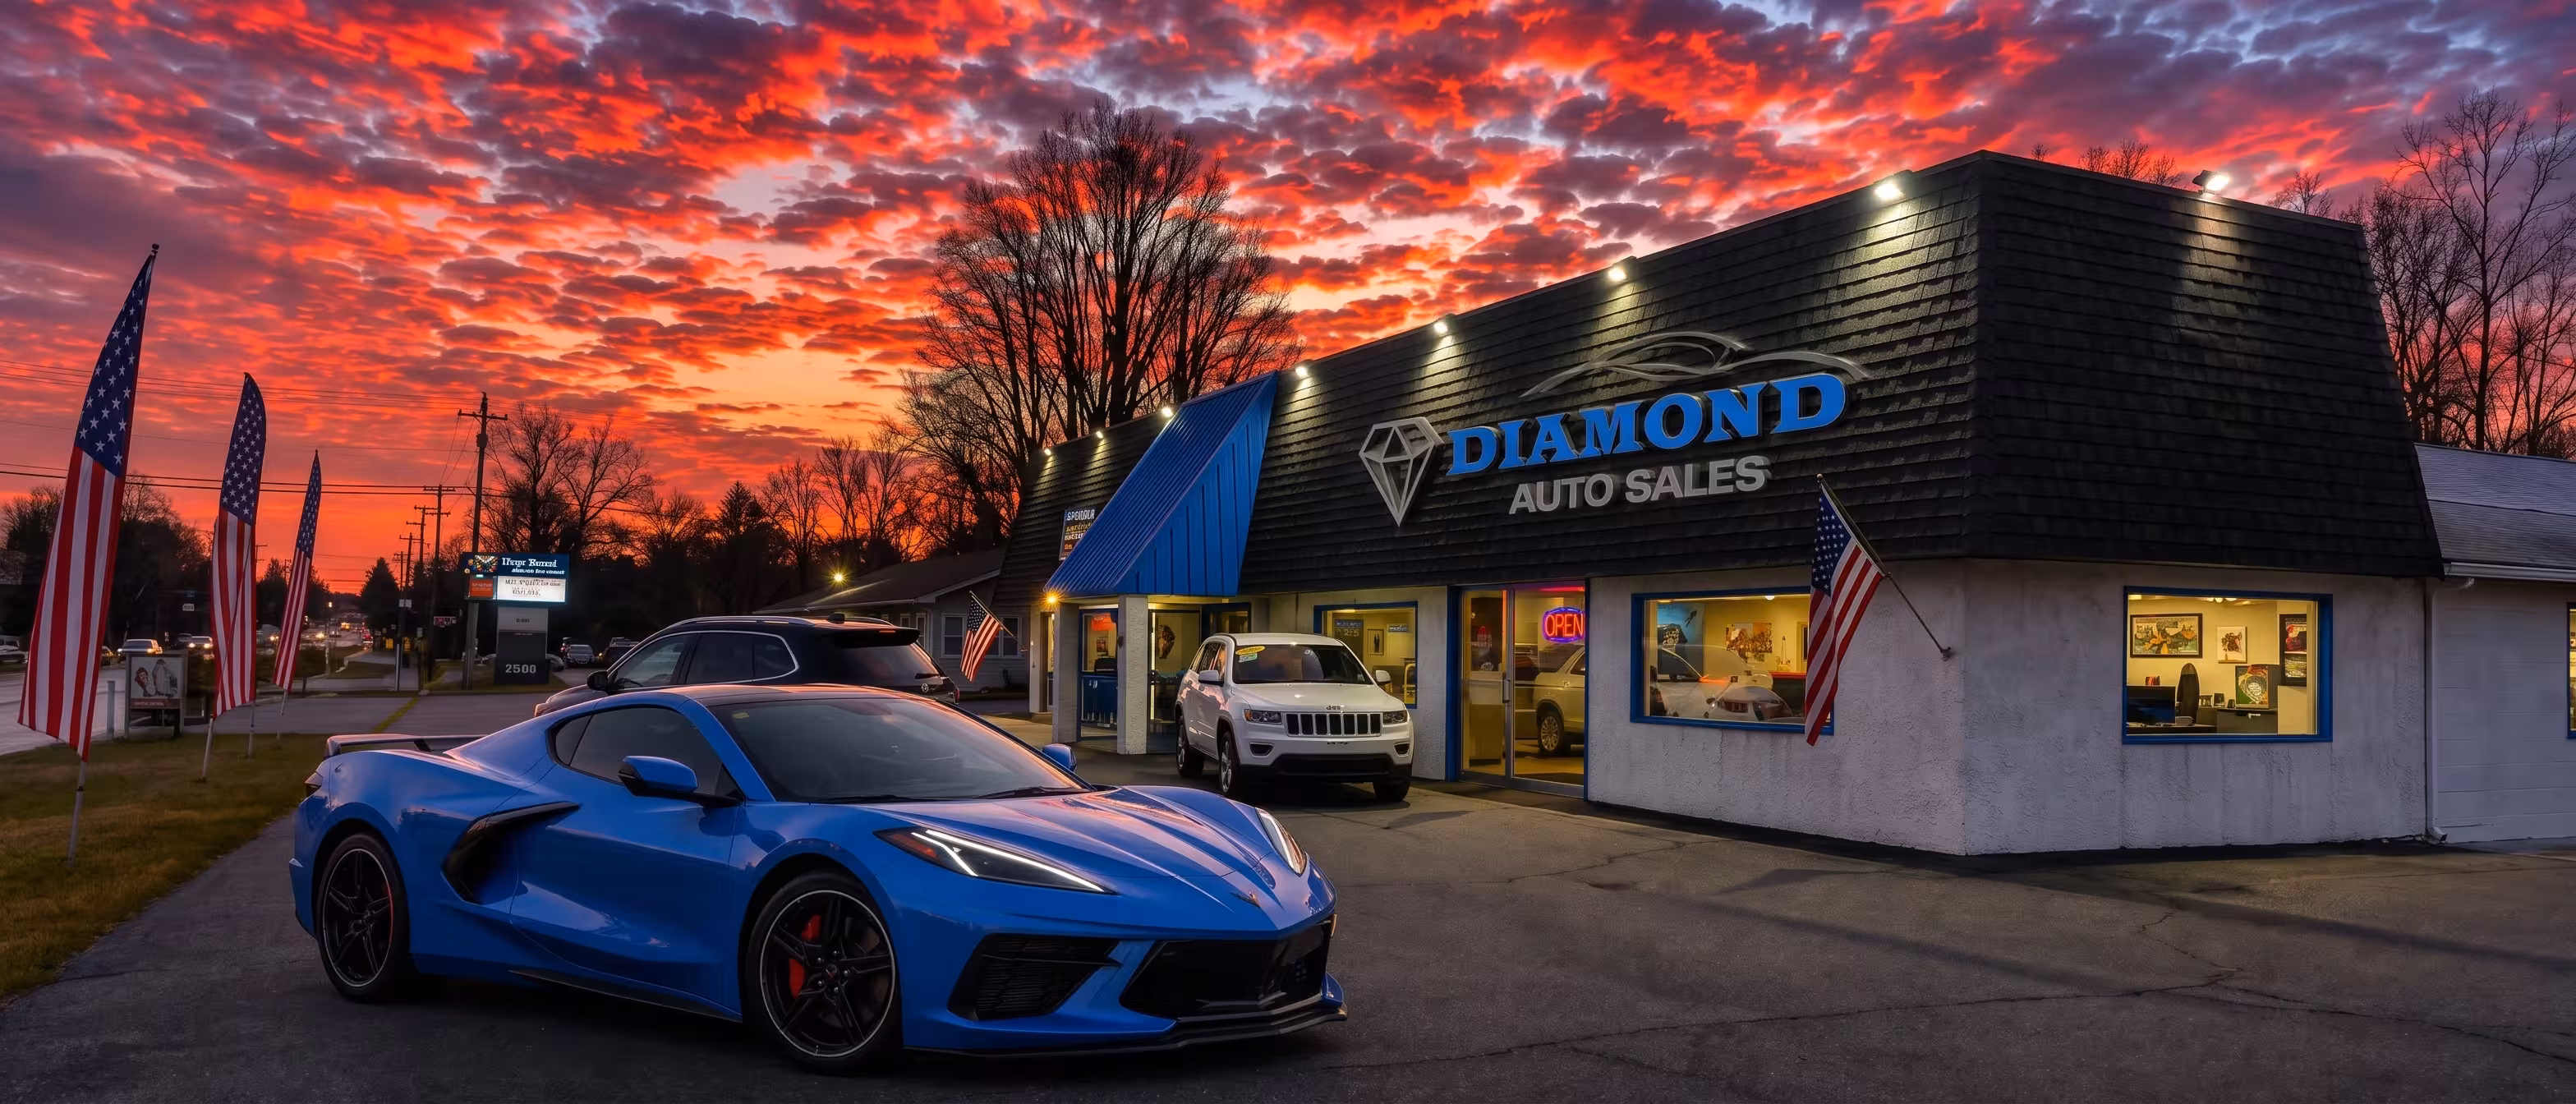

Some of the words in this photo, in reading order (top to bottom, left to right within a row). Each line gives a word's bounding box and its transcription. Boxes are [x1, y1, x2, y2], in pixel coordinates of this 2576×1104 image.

[1446, 372, 1848, 476] DIAMOND
[1508, 472, 1617, 515] AUTO
[1626, 454, 1770, 504] SALES
[1544, 613, 1584, 637] OPEN
[505, 664, 536, 674] 2500
